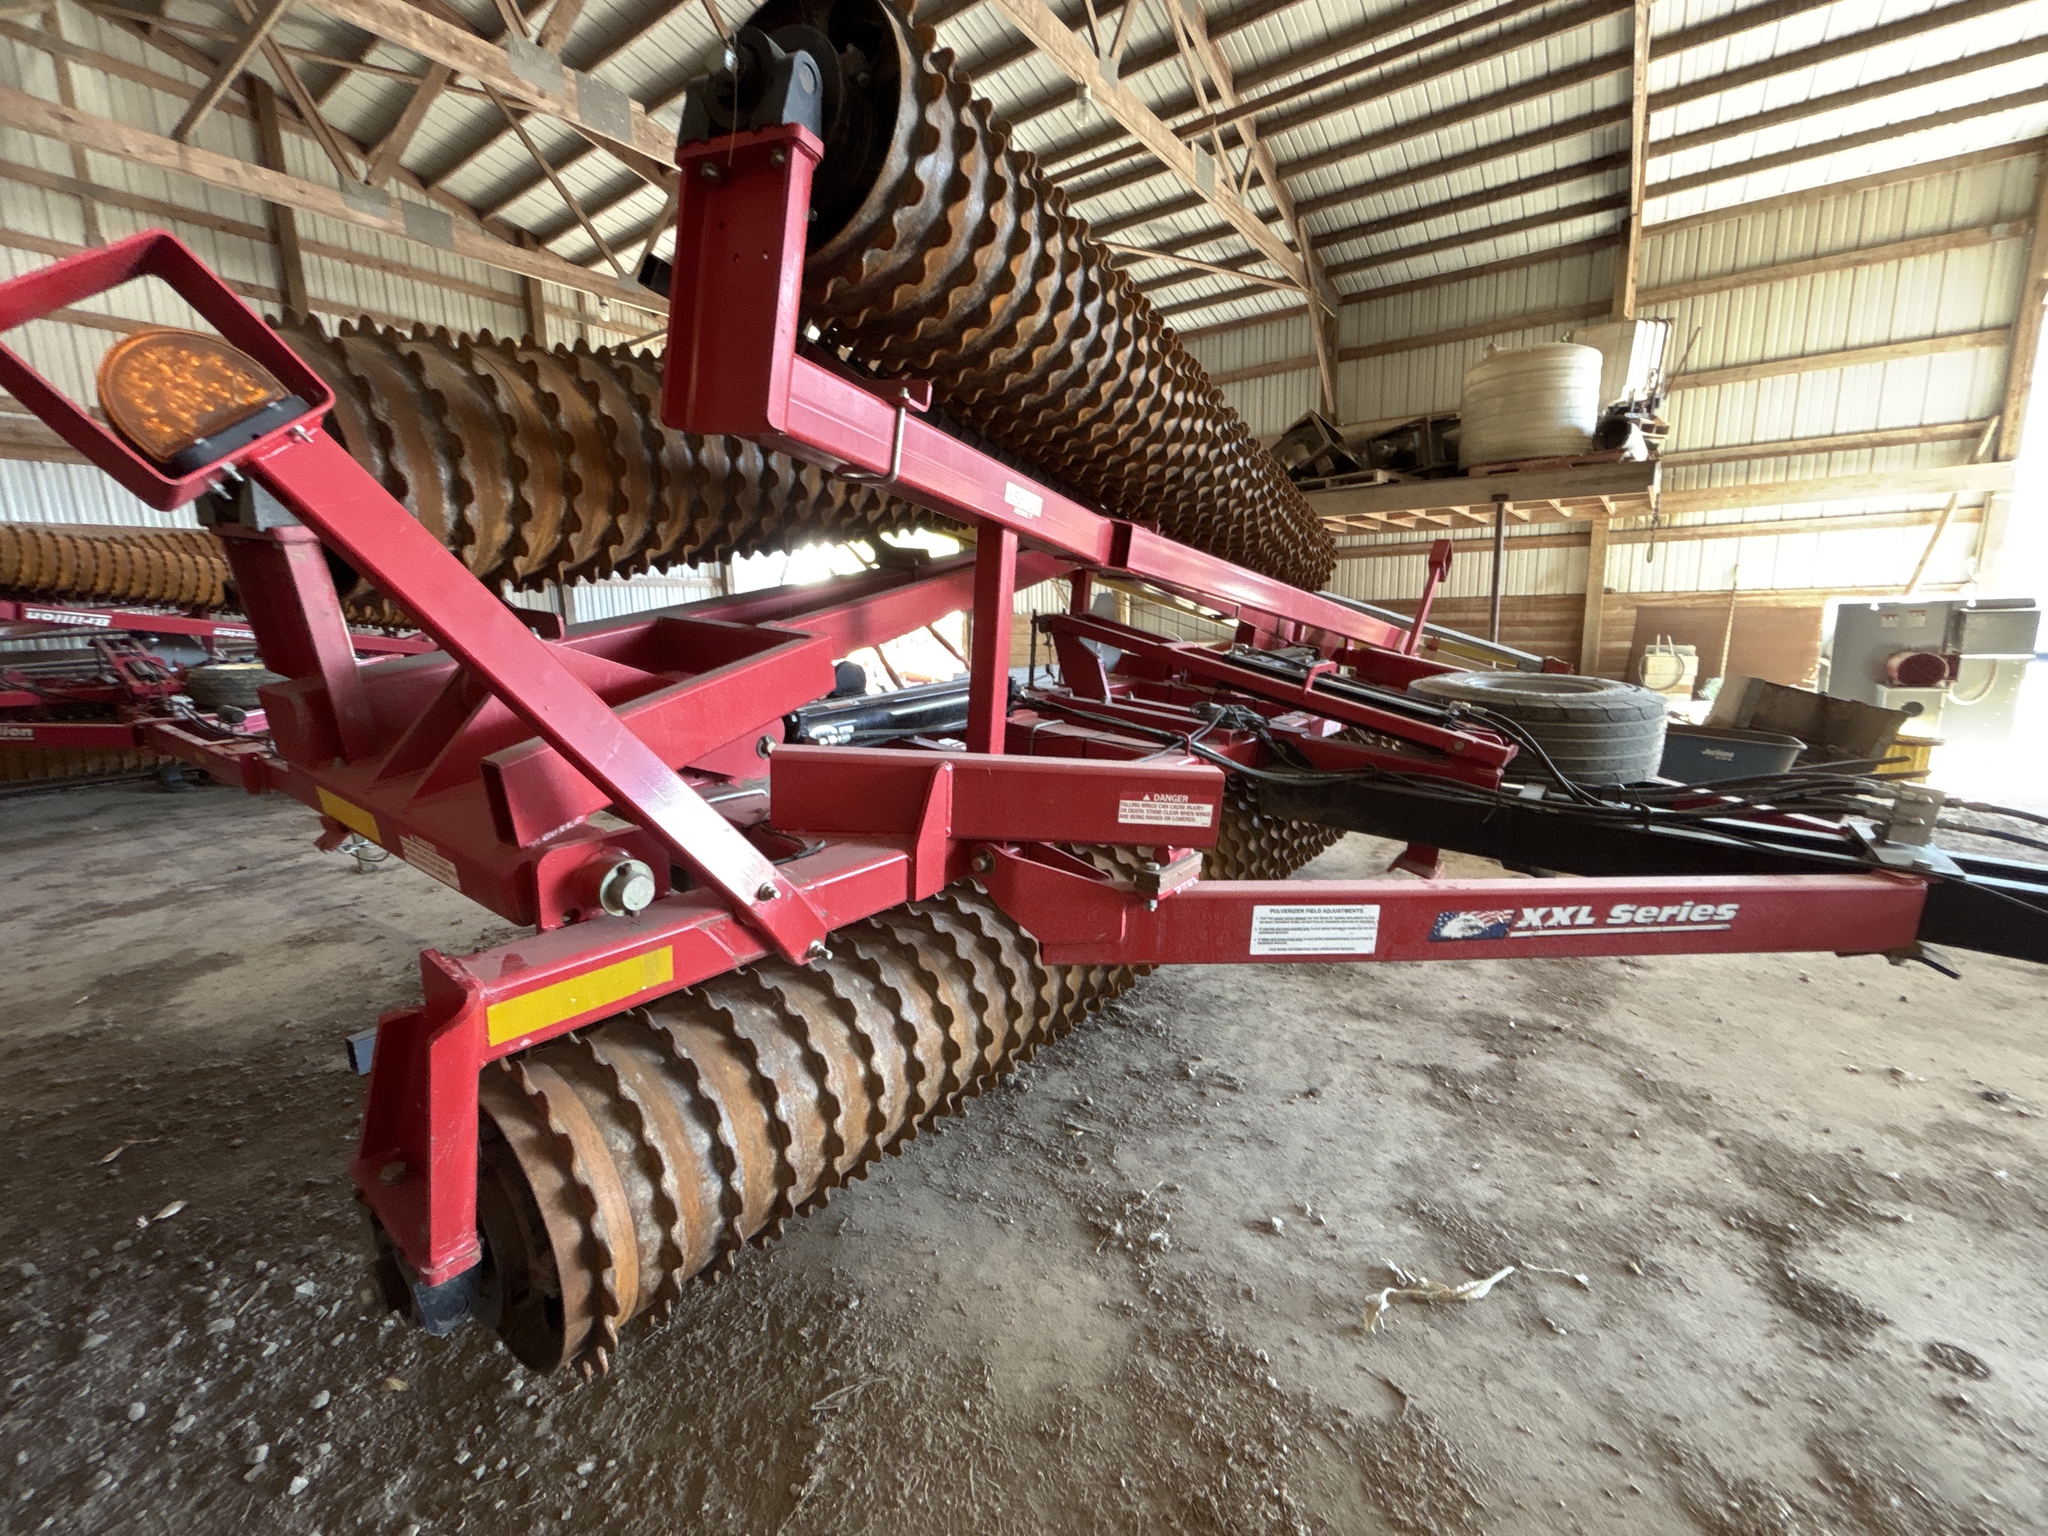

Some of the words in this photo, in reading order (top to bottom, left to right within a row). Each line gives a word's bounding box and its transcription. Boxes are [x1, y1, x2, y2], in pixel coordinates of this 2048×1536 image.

[25, 611, 111, 627] Brillion
[1153, 793, 1189, 803] DANGER
[1513, 905, 1597, 928] XXL
[1606, 901, 1741, 925] Series
